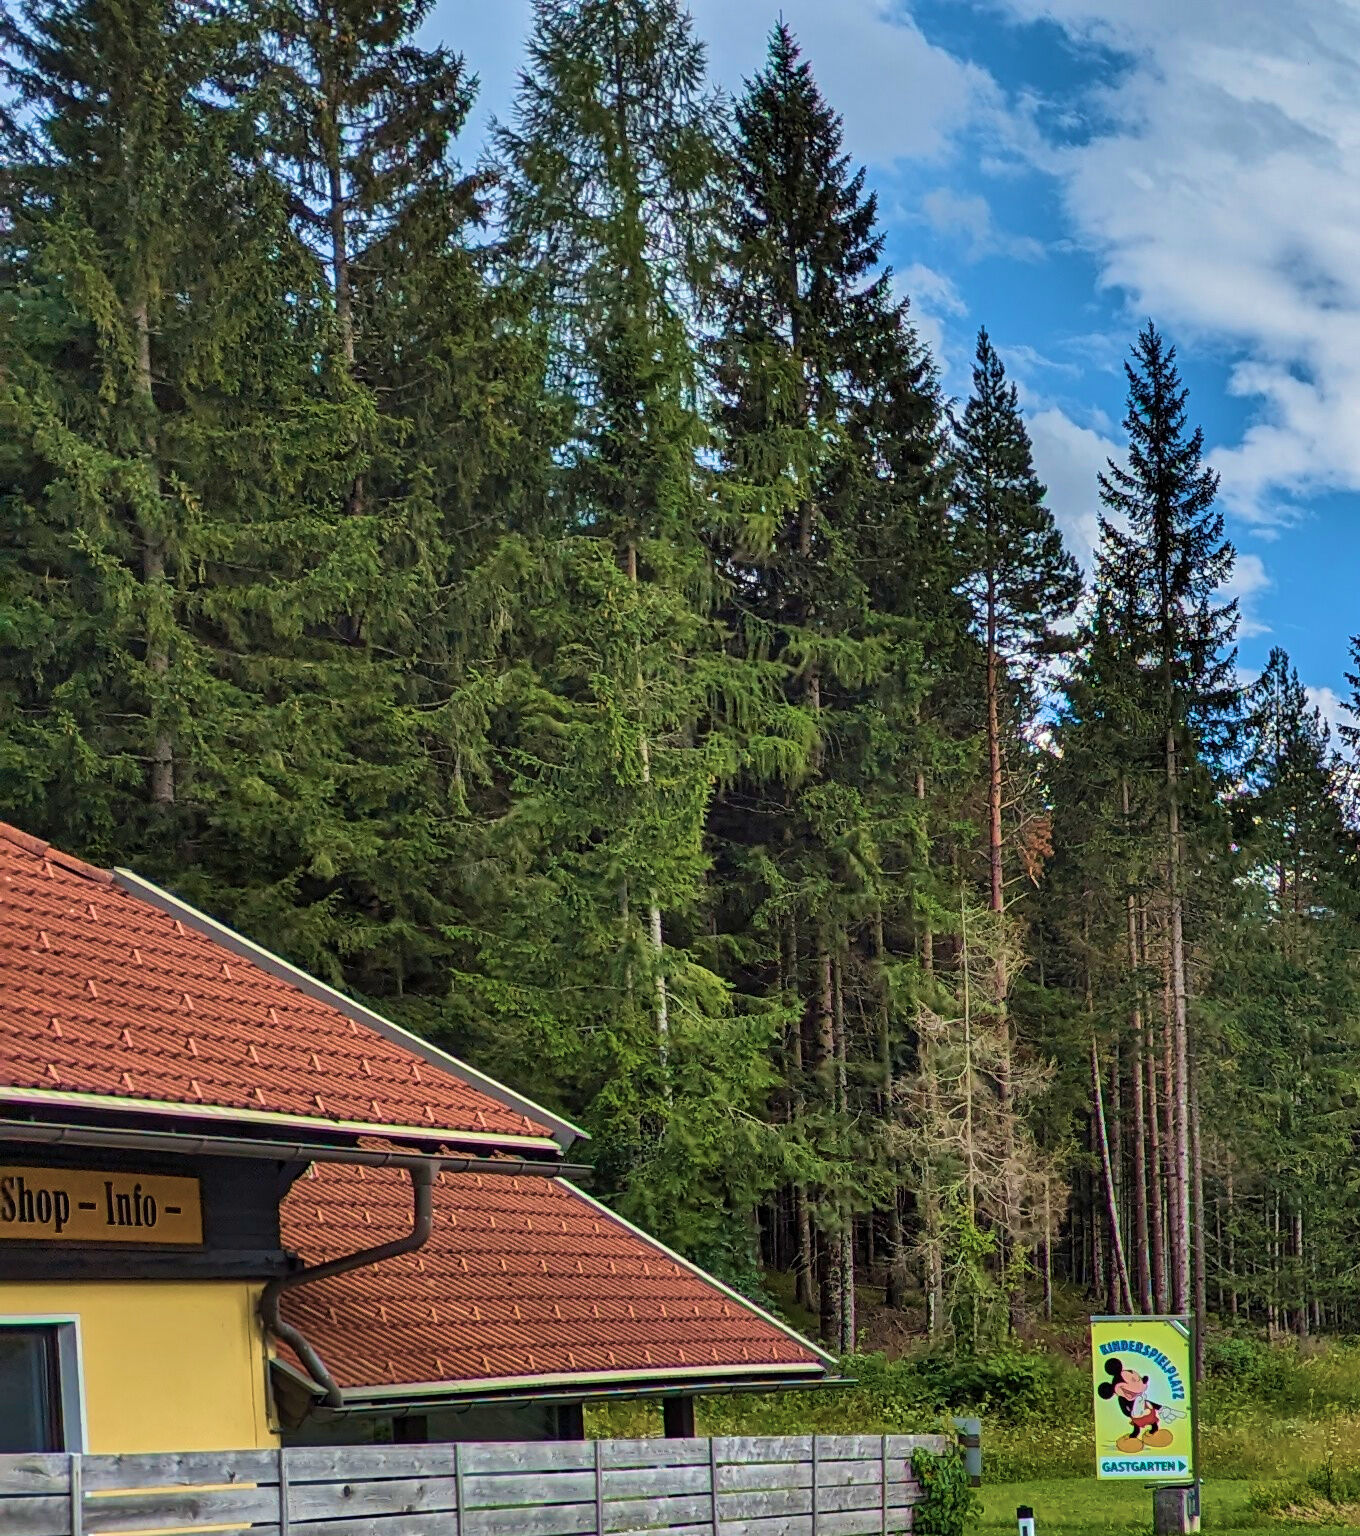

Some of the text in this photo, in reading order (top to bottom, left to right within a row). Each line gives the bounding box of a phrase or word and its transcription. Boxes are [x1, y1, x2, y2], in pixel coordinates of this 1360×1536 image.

[1, 1176, 70, 1233] Shop
[104, 1181, 157, 1228] Info
[1101, 1460, 1176, 1473] GASTGARTEN
